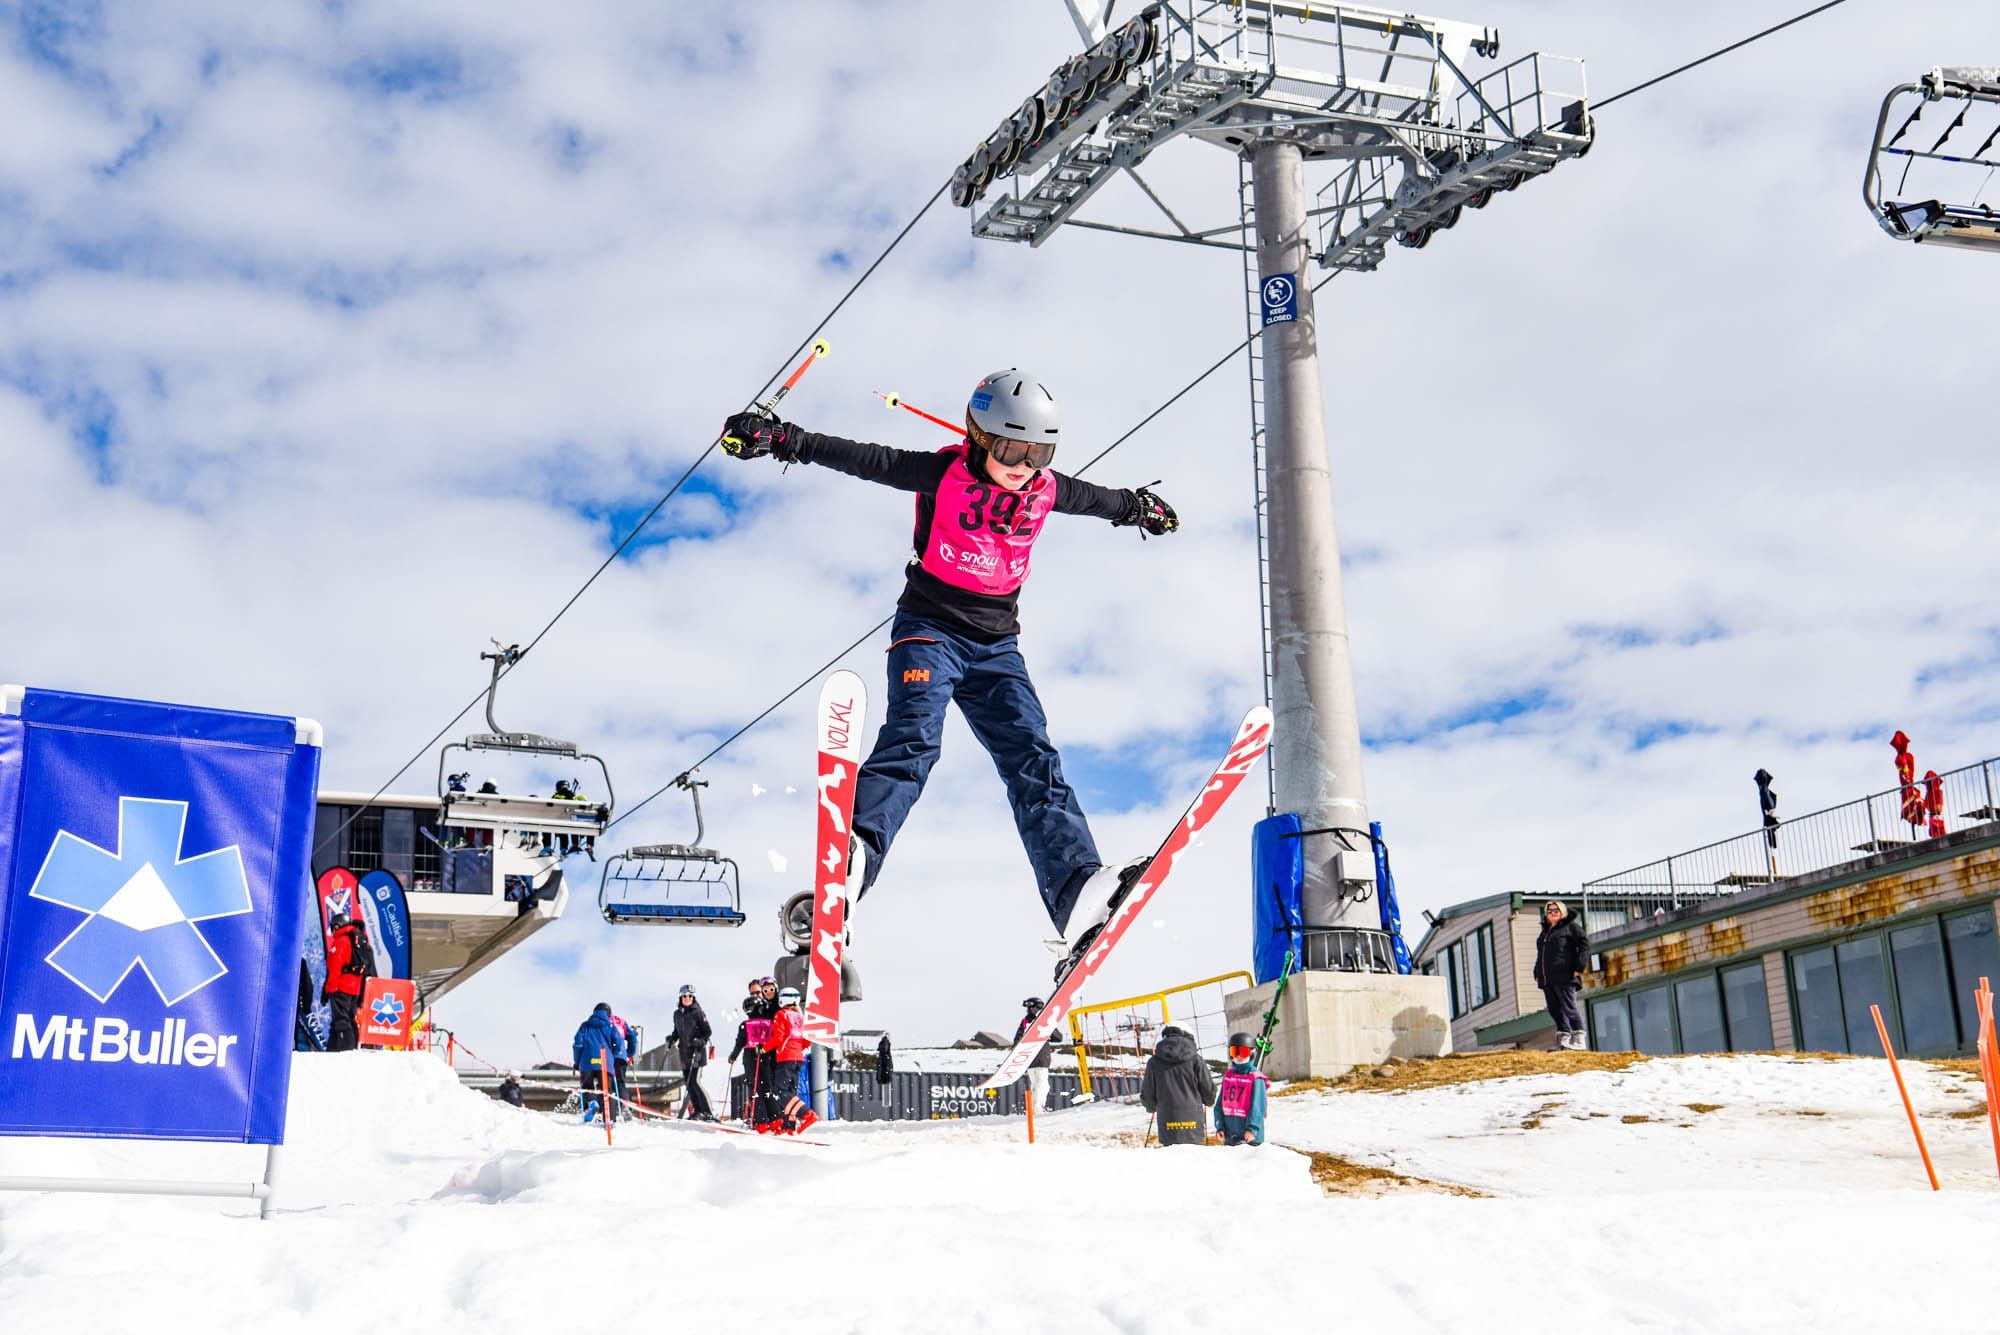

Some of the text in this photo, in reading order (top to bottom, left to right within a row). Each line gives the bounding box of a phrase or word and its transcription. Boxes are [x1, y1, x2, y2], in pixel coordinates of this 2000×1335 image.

[1269, 307, 1287, 316] KEEP
[1266, 314, 1292, 325] CLOSED
[959, 483, 1038, 536] 392
[960, 551, 1000, 566] snow
[904, 669, 930, 683] HH
[387, 903, 404, 947] Caulfield
[12, 1013, 238, 1068] Mt Buller
[930, 1085, 985, 1099] SNOW
[931, 1100, 997, 1113] FACTORY
